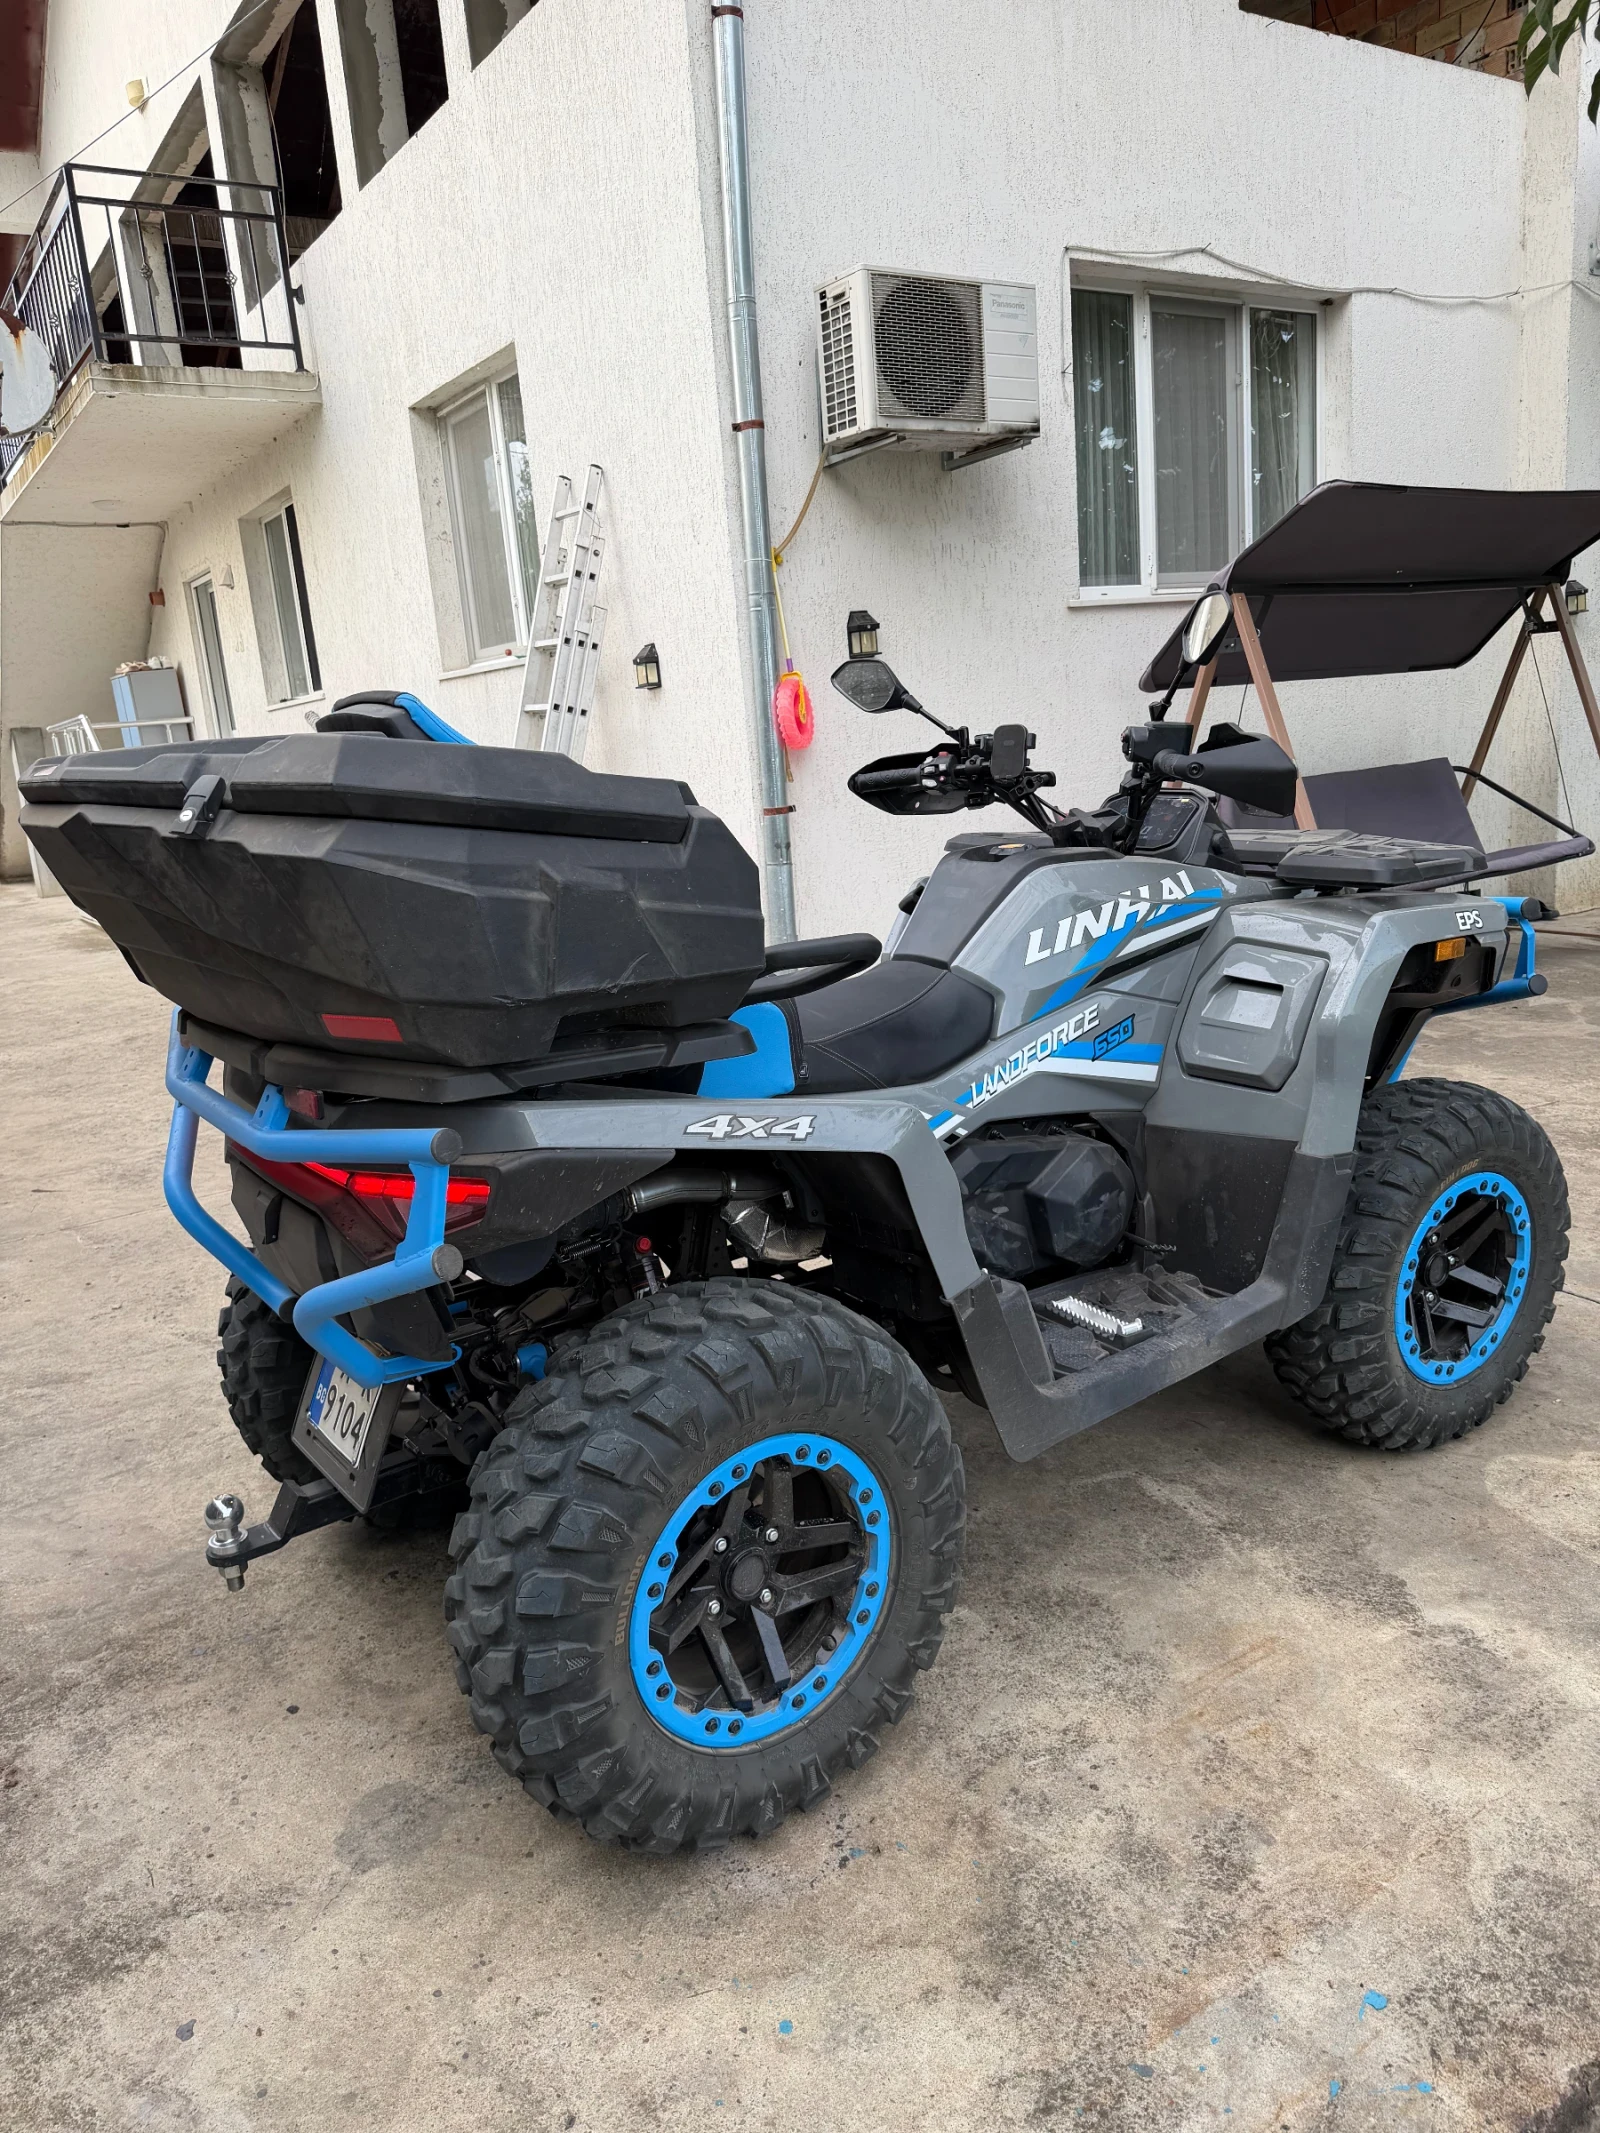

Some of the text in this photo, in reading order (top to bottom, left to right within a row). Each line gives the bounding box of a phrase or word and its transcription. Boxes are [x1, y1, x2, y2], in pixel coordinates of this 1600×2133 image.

[992, 299, 1026, 310] Panasonic
[1024, 869, 1196, 966] LINHAI
[1455, 909, 1484, 931] EPS
[970, 1003, 1135, 1109] LANDFORCE 650
[316, 1384, 327, 1404] BG
[323, 1384, 367, 1450] 9104
[614, 1553, 646, 1647] BULLDOG
